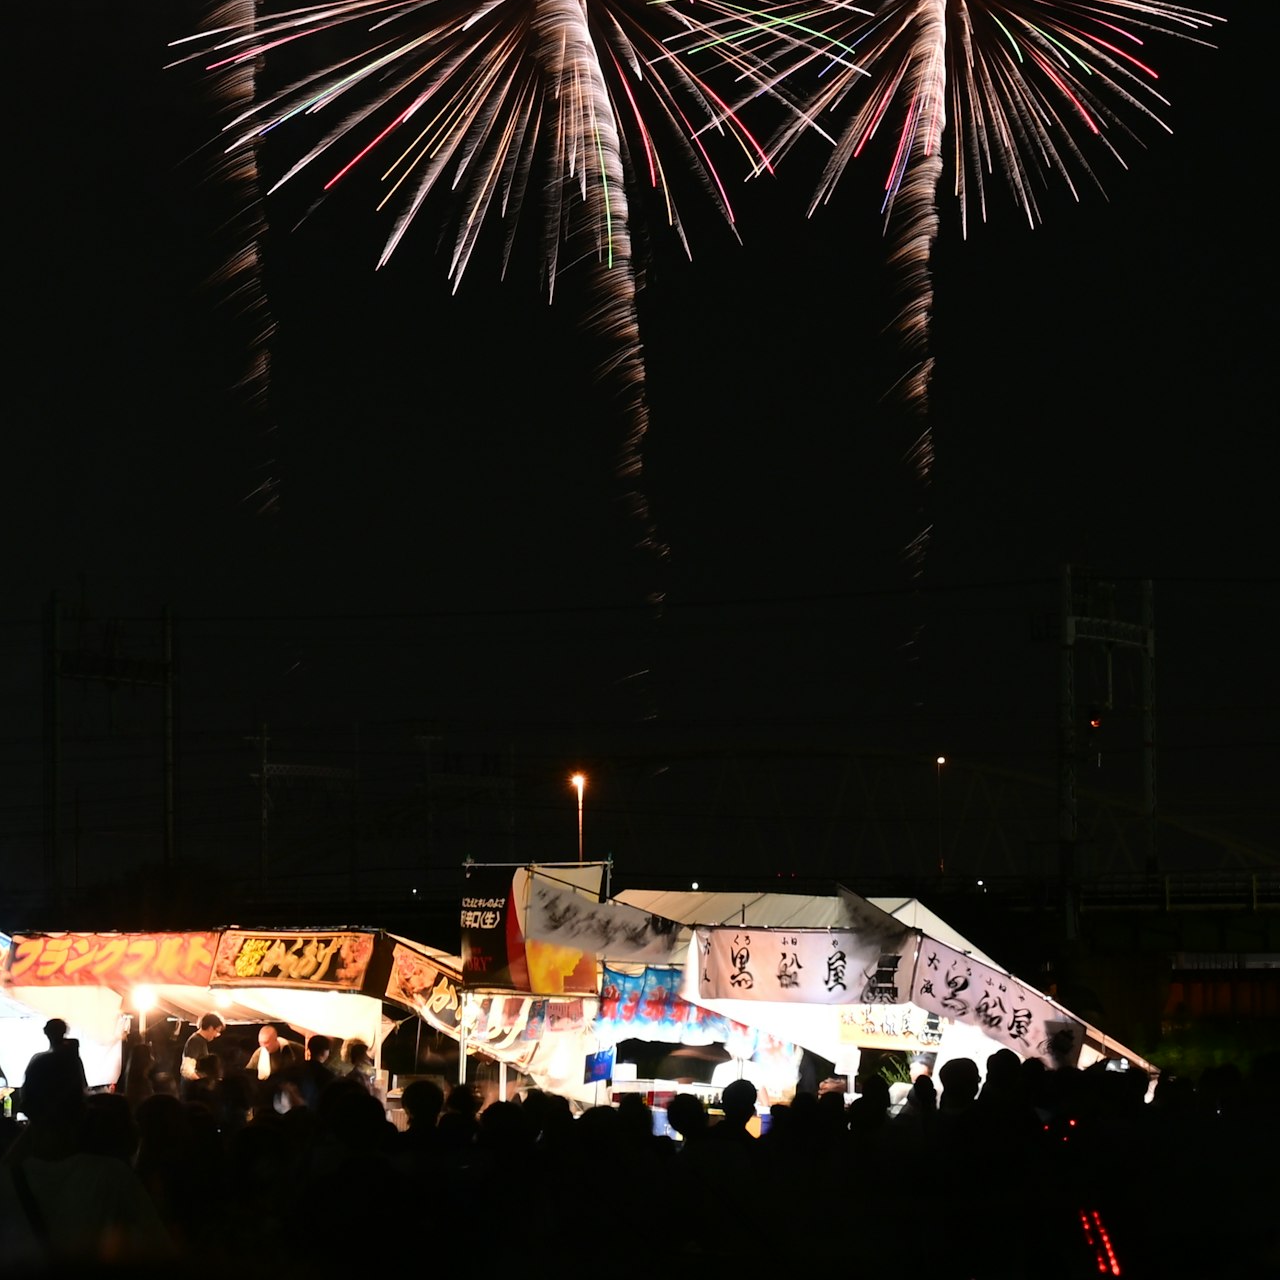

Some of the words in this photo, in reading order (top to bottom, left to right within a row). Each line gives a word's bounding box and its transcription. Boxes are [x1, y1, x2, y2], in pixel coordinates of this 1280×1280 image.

[11, 937, 211, 977] フランクフルト
[733, 934, 751, 946] くろ
[730, 946, 847, 992] 黒船屋
